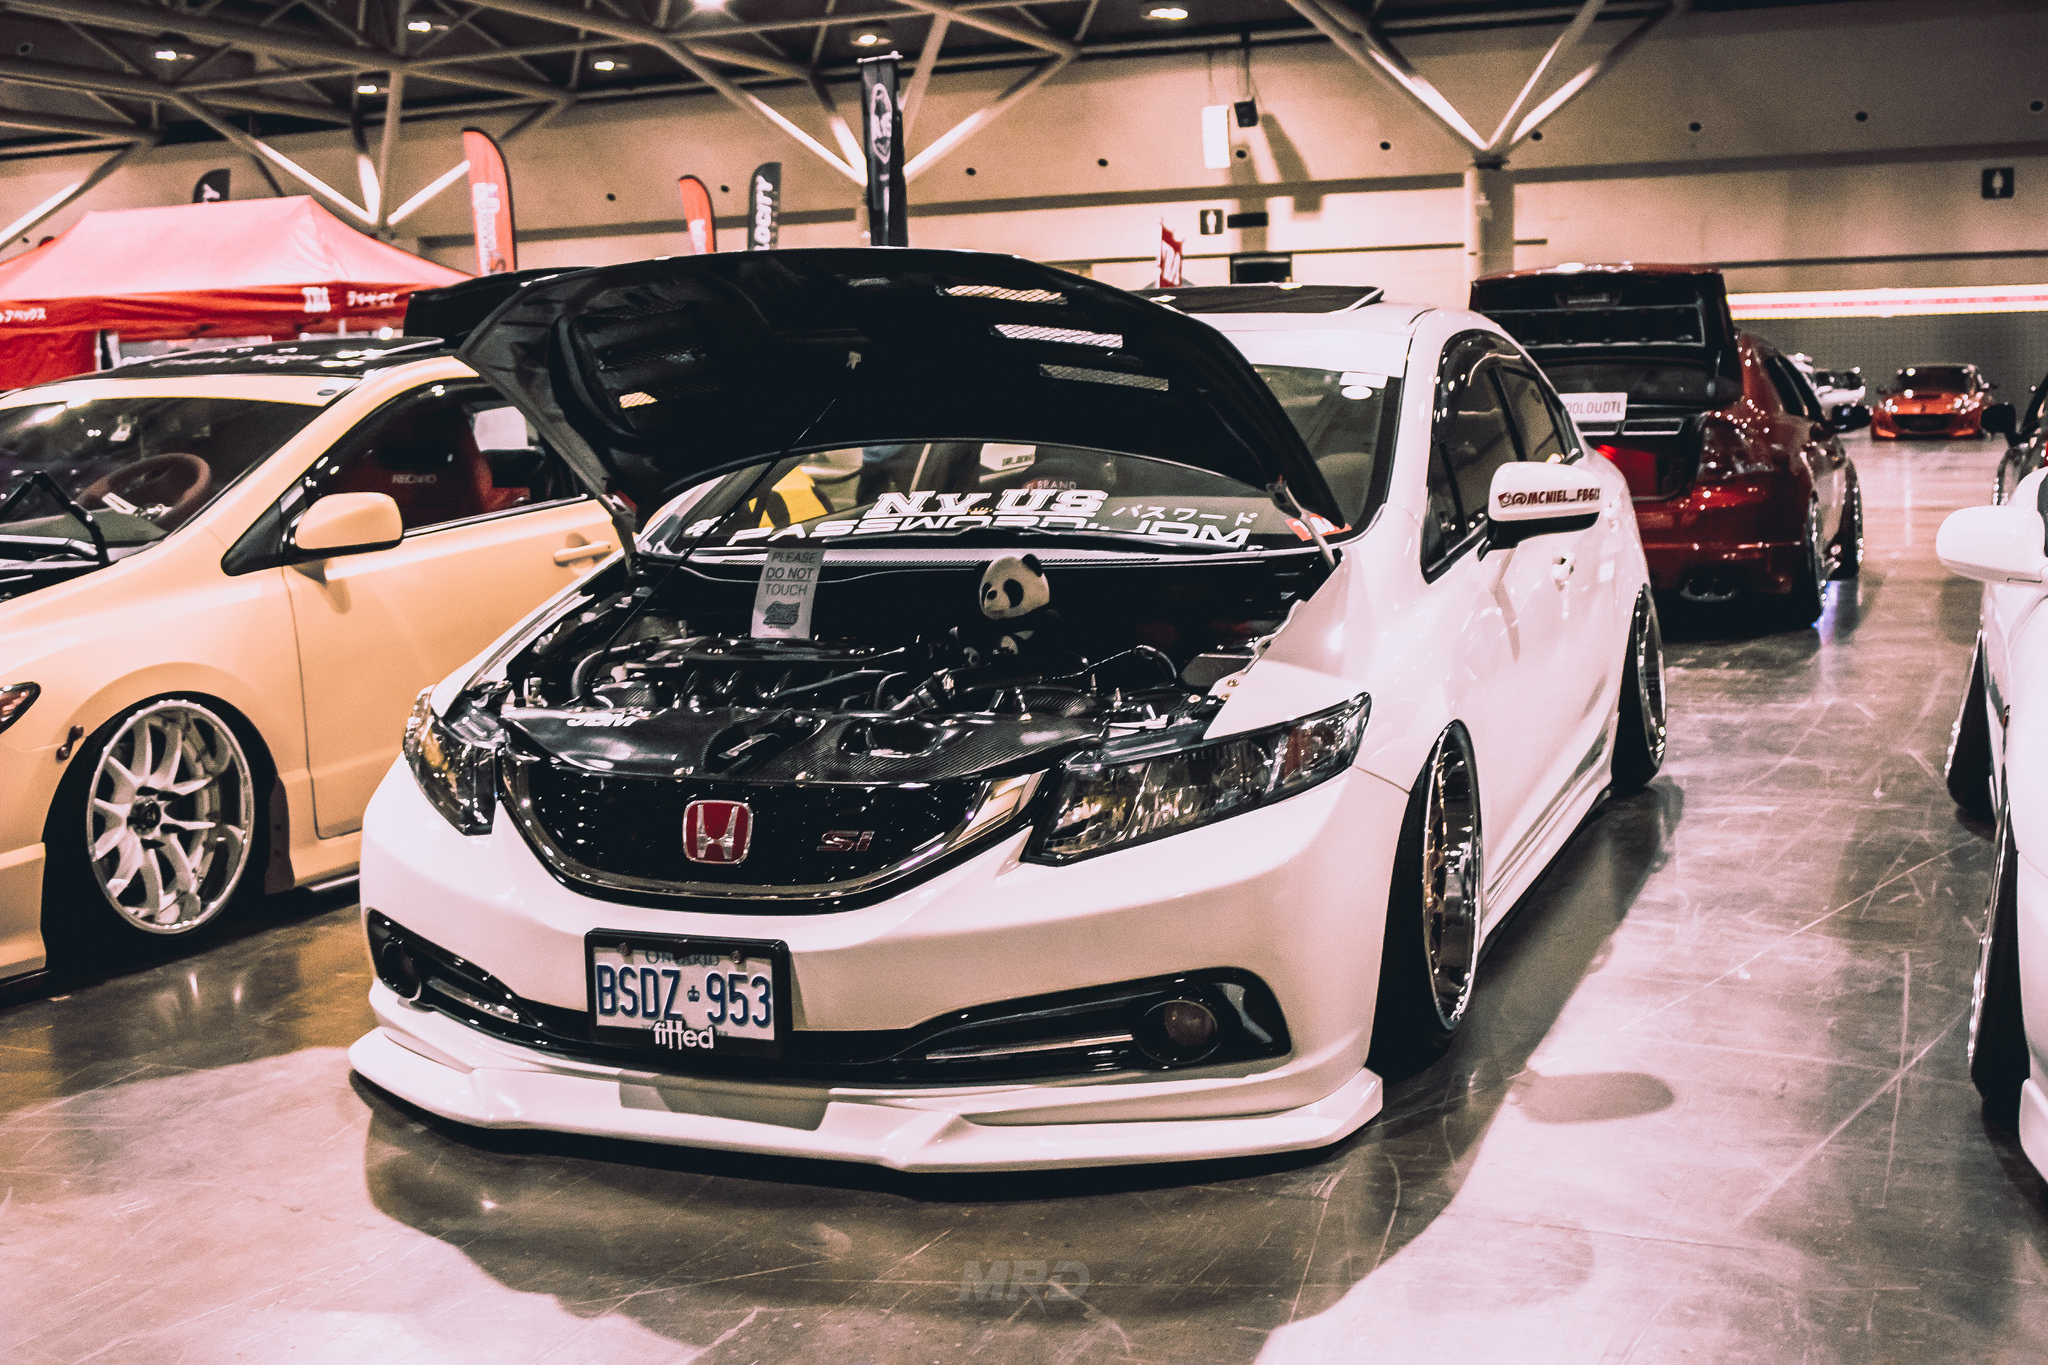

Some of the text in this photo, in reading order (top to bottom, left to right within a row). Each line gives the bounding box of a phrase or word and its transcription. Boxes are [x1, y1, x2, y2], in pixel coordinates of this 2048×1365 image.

[1111, 504, 1259, 527] パスワード
[771, 551, 818, 564] PLEASE
[765, 567, 814, 580] DO NOT
[765, 583, 808, 596] TOUCH
[597, 964, 772, 1028] BSDZ 953
[653, 1018, 715, 1051] fitted
